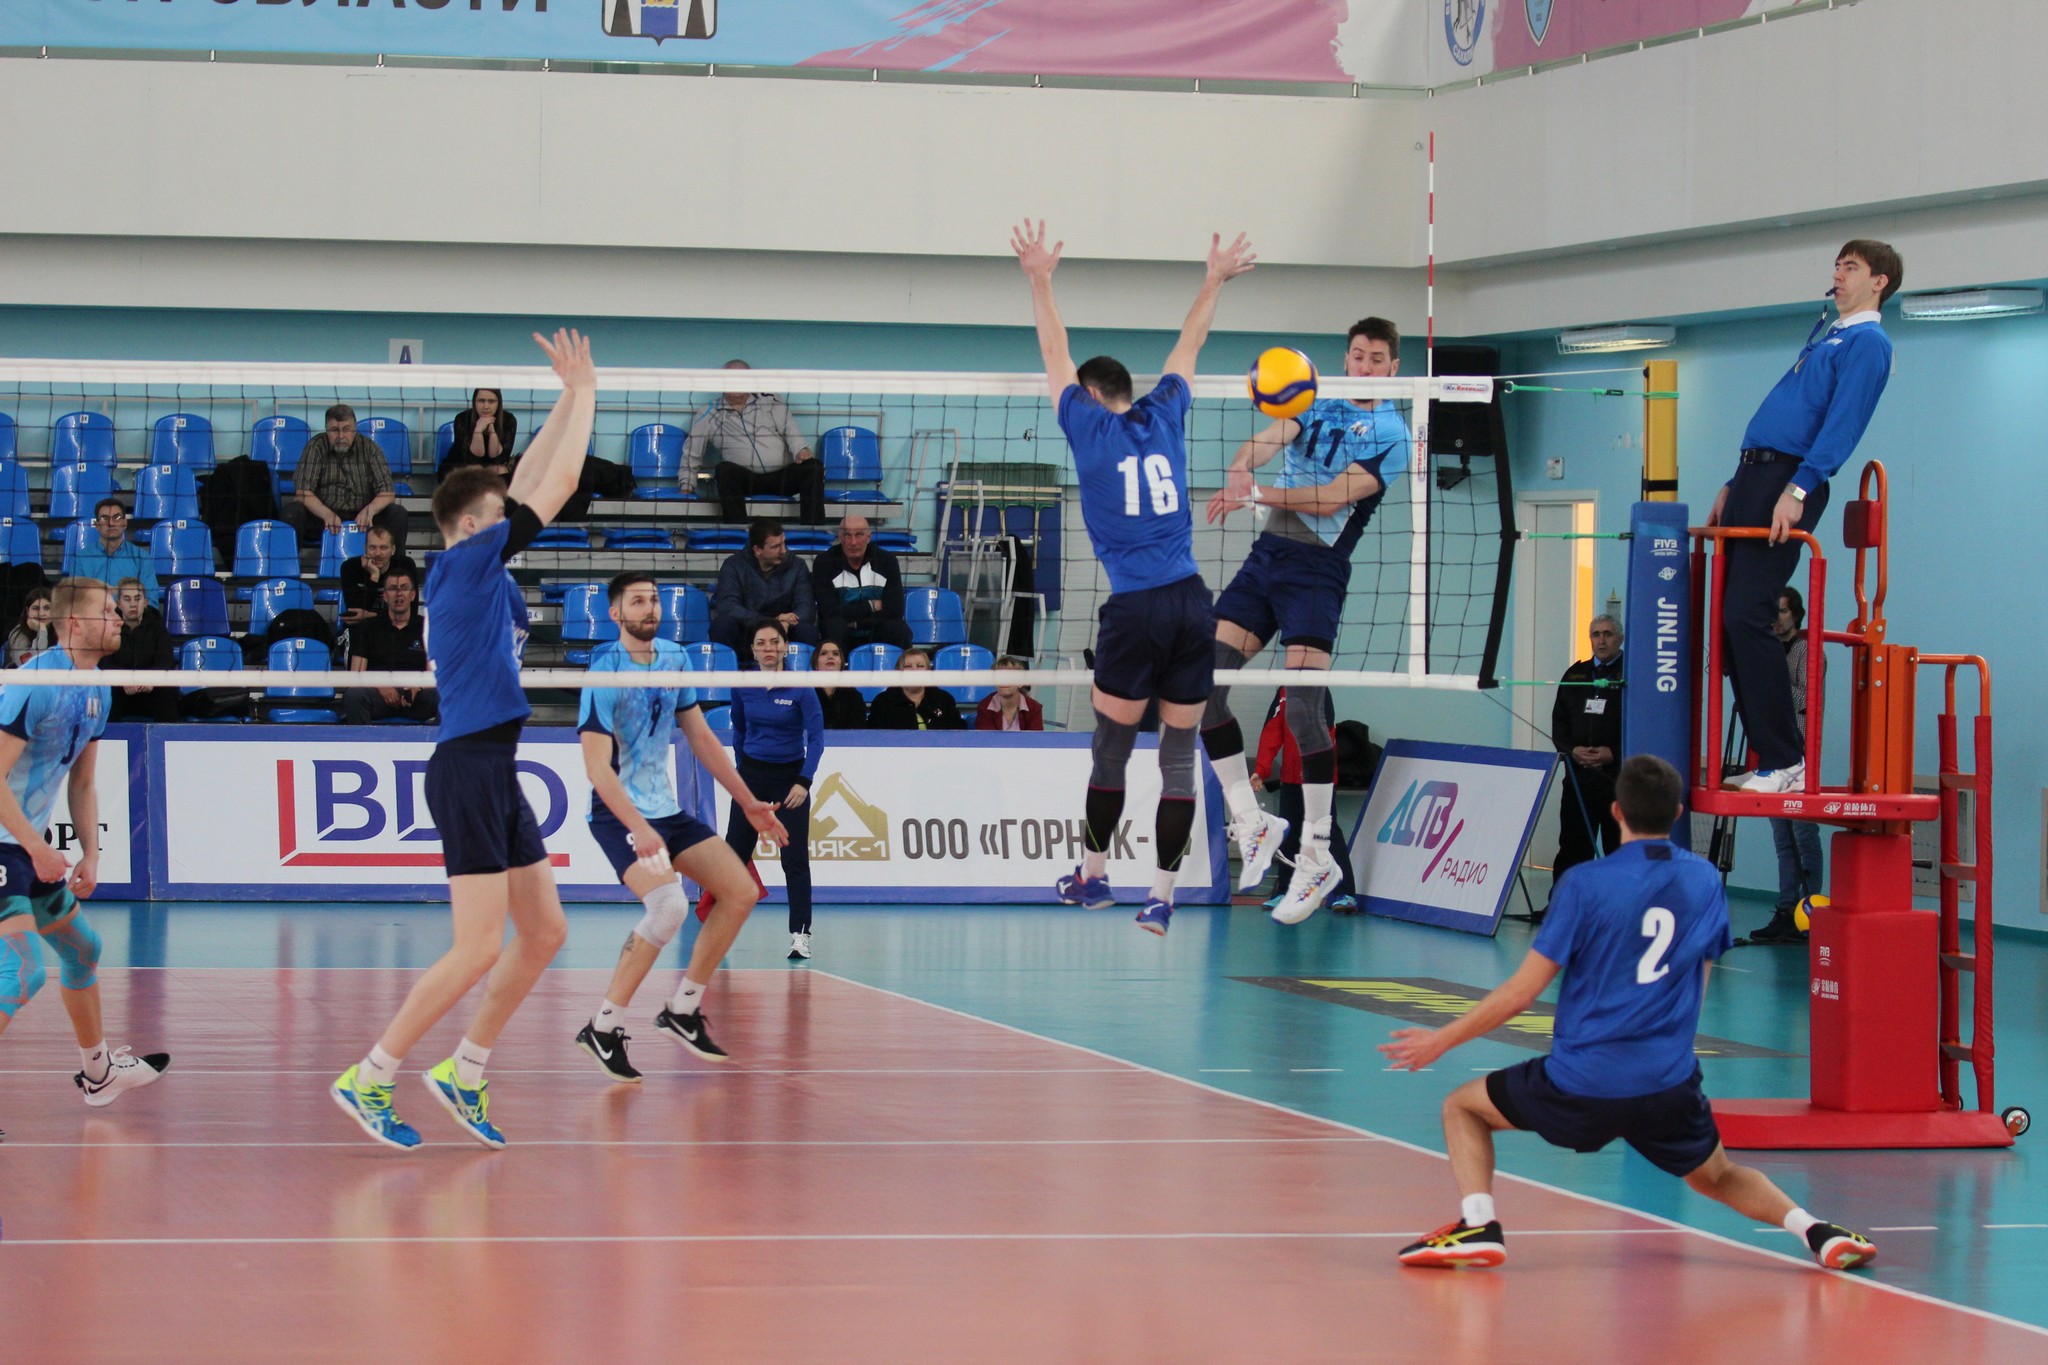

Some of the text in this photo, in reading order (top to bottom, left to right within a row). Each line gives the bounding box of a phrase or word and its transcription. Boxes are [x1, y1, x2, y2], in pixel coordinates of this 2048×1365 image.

[1305, 419, 1346, 468] 11
[1117, 453, 1179, 516] 16
[1653, 538, 1678, 549] FIVB
[1656, 597, 1678, 692] JINLING
[1783, 800, 1803, 808] FIVB
[902, 818, 969, 860] ООО
[1440, 857, 1488, 888] РАДИО
[1637, 906, 1676, 984] 2
